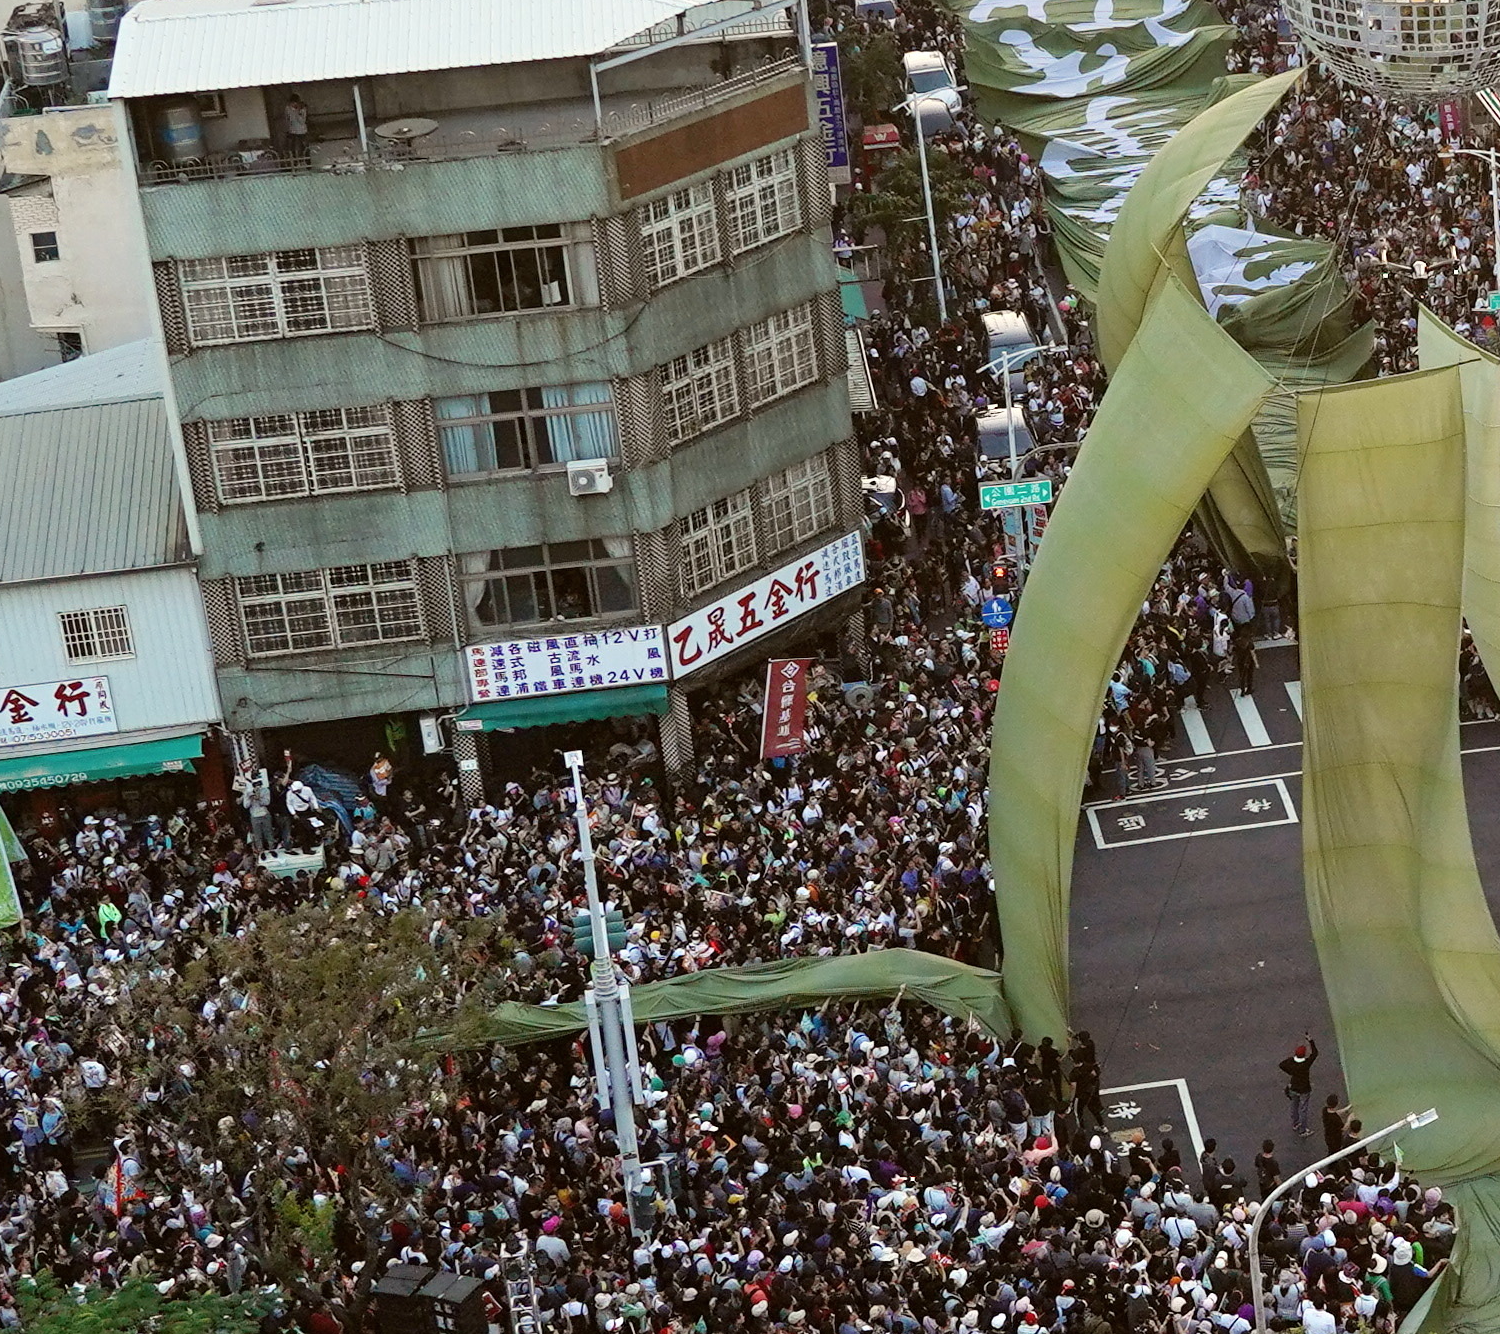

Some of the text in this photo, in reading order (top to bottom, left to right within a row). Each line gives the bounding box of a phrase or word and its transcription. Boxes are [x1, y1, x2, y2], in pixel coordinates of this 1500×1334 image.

[673, 560, 821, 667] 乙晟五金行
[602, 629, 640, 645] 12V
[607, 667, 645, 683] 24V
